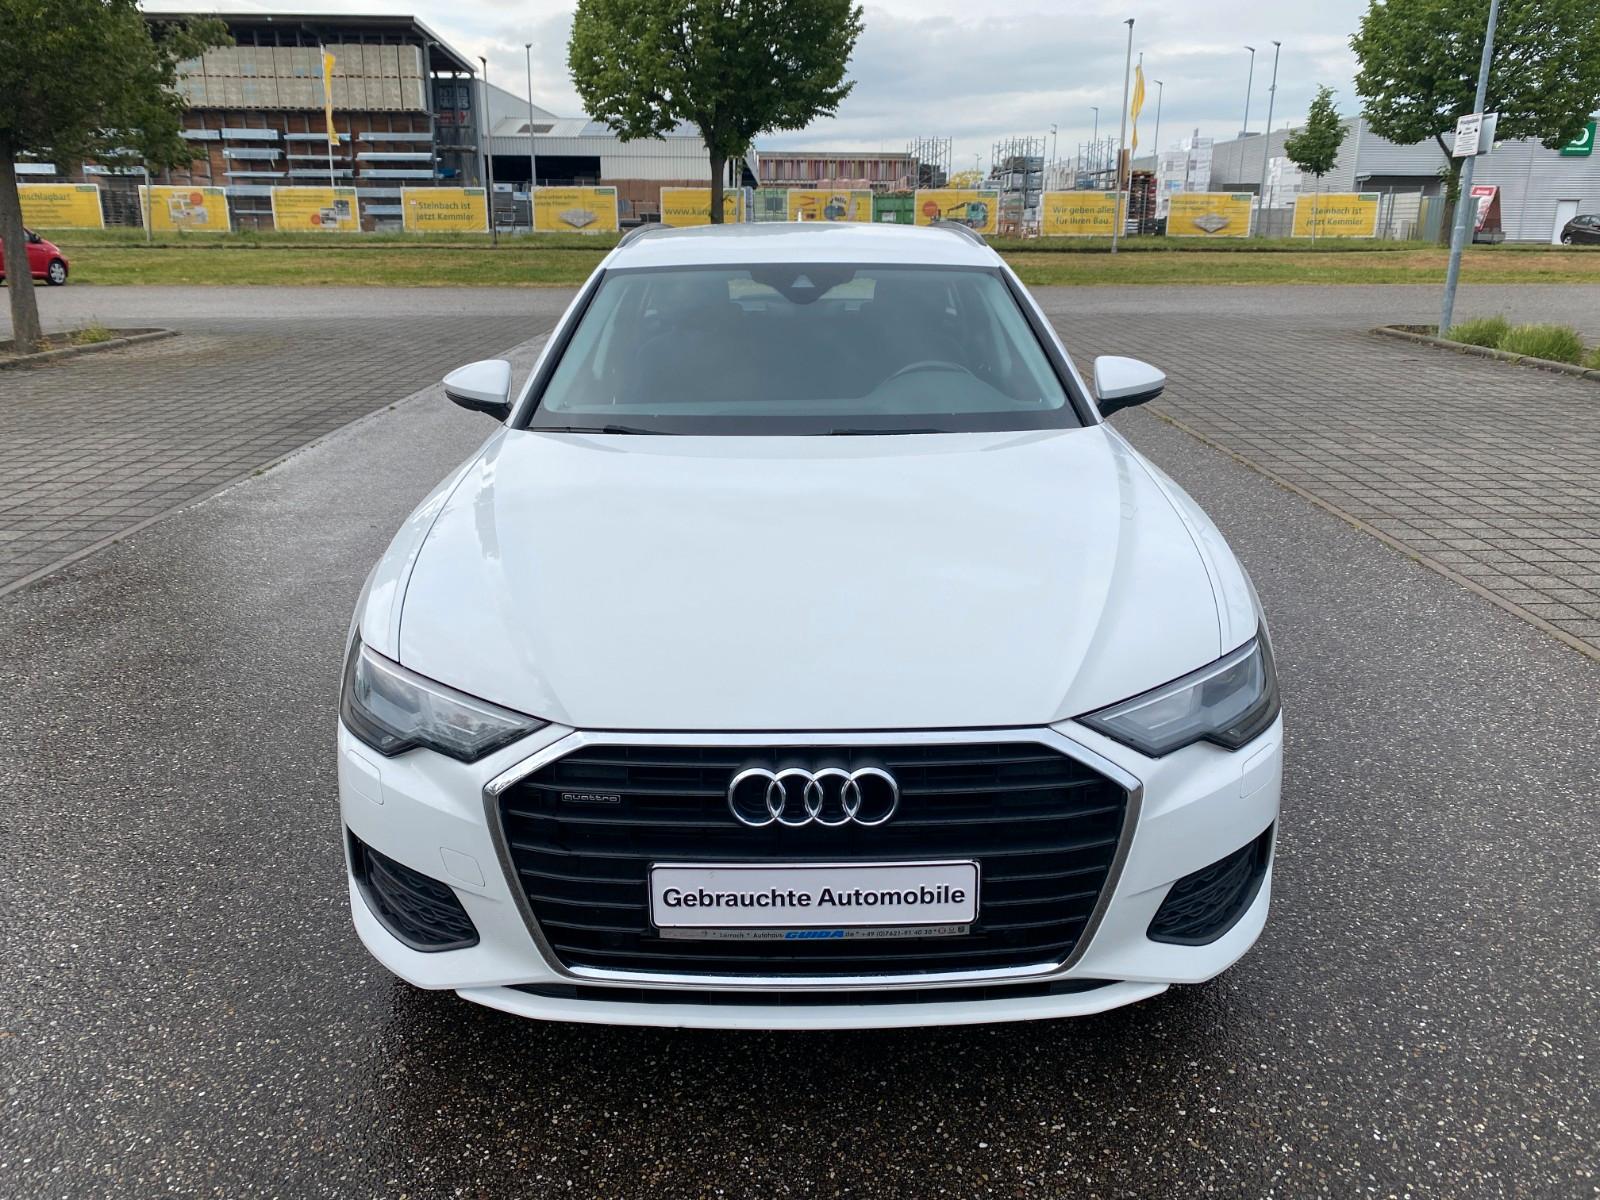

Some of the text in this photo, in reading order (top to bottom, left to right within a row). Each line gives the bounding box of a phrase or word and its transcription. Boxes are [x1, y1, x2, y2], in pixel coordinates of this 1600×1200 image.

[418, 200, 471, 210] Steinbach ist
[1070, 206, 1095, 215] geben
[1352, 207, 1362, 215] ist
[416, 213, 474, 223] jetzt Kemmler
[1056, 217, 1067, 225] für
[1070, 217, 1091, 225] Ihren
[564, 794, 618, 802] quattro
[662, 885, 966, 908] Gebrauchte Automobile
